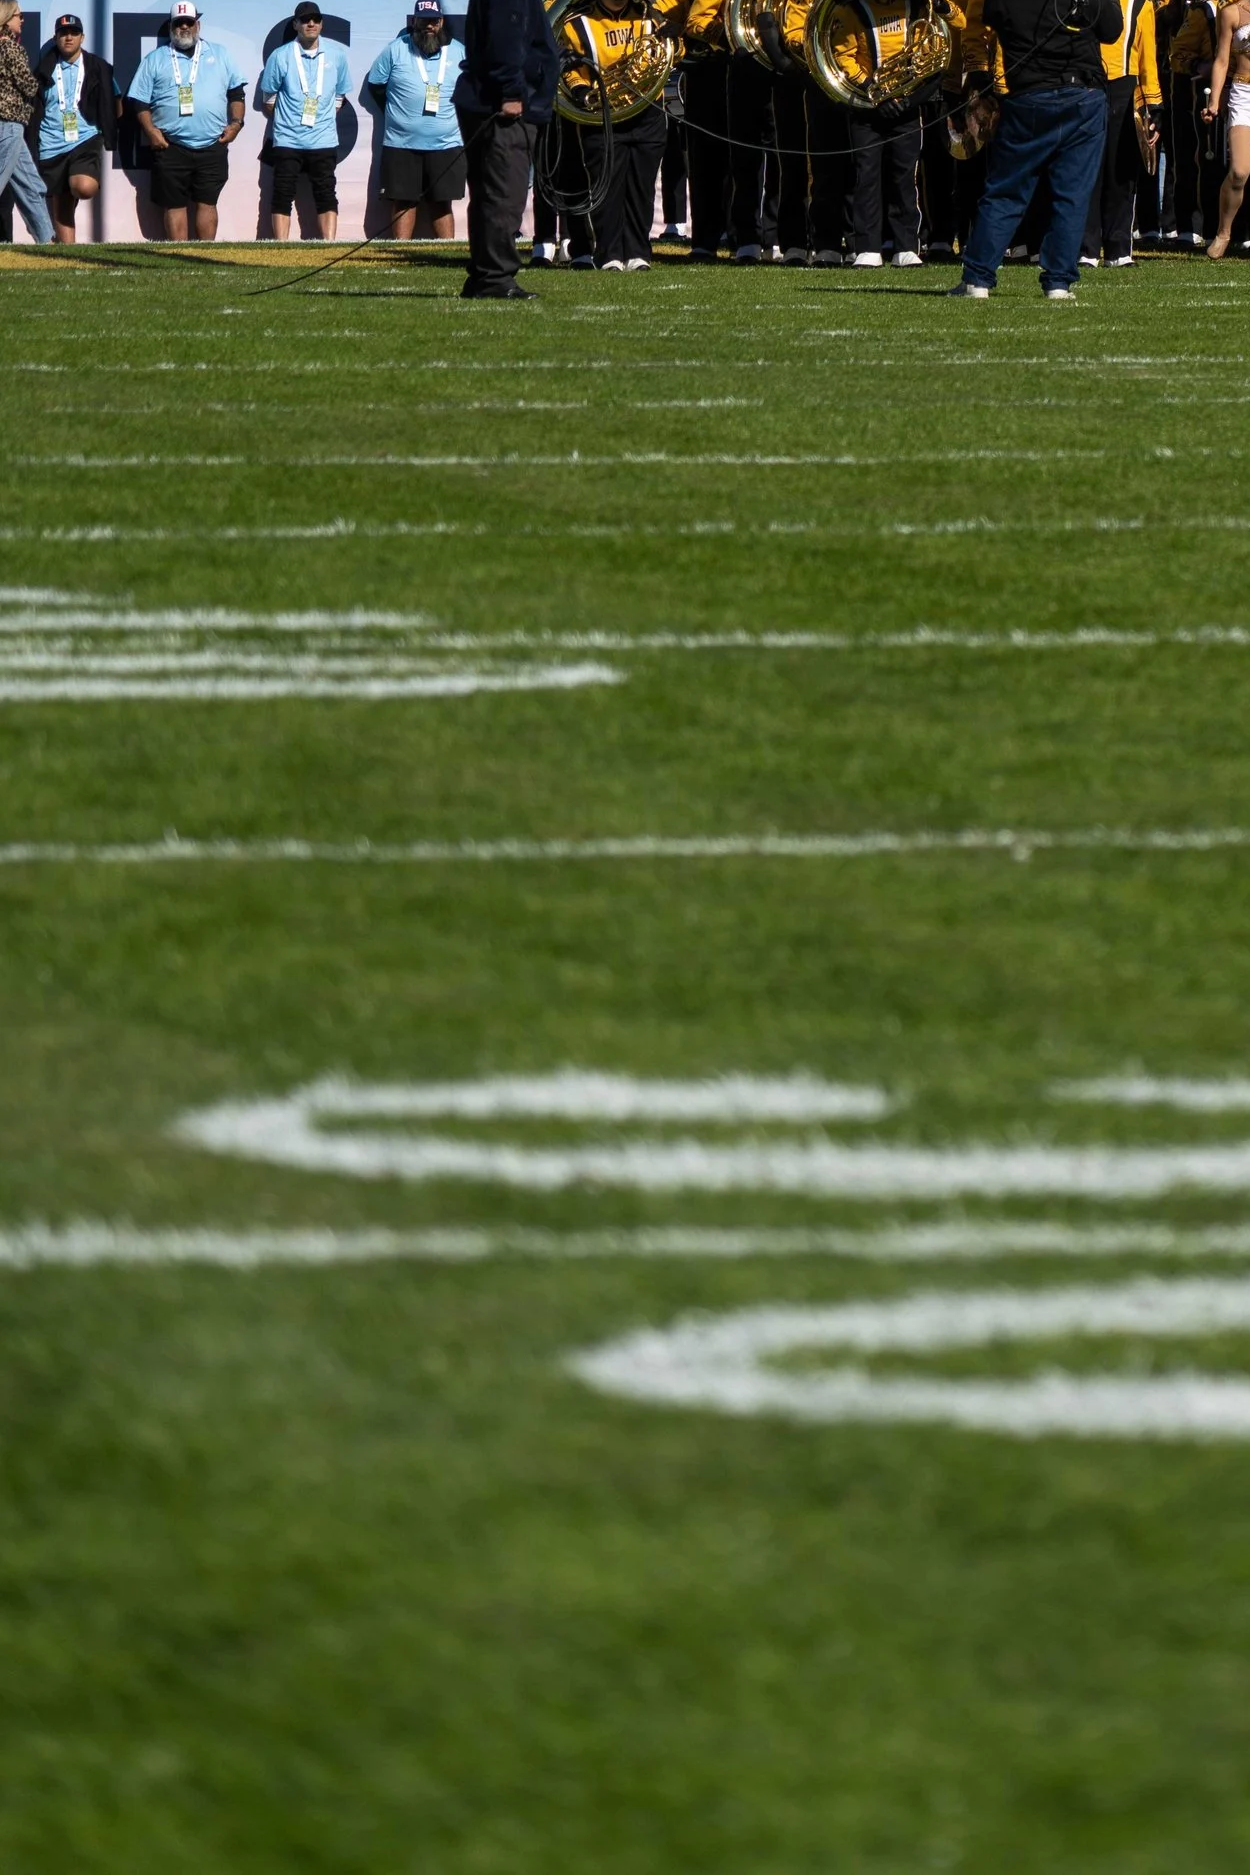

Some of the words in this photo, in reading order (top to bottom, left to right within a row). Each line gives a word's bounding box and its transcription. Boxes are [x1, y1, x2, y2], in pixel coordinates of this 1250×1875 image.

[177, 4, 187, 14] H
[417, 1, 439, 12] USA
[879, 14, 903, 34] IOWA
[604, 28, 636, 47] IOWA
